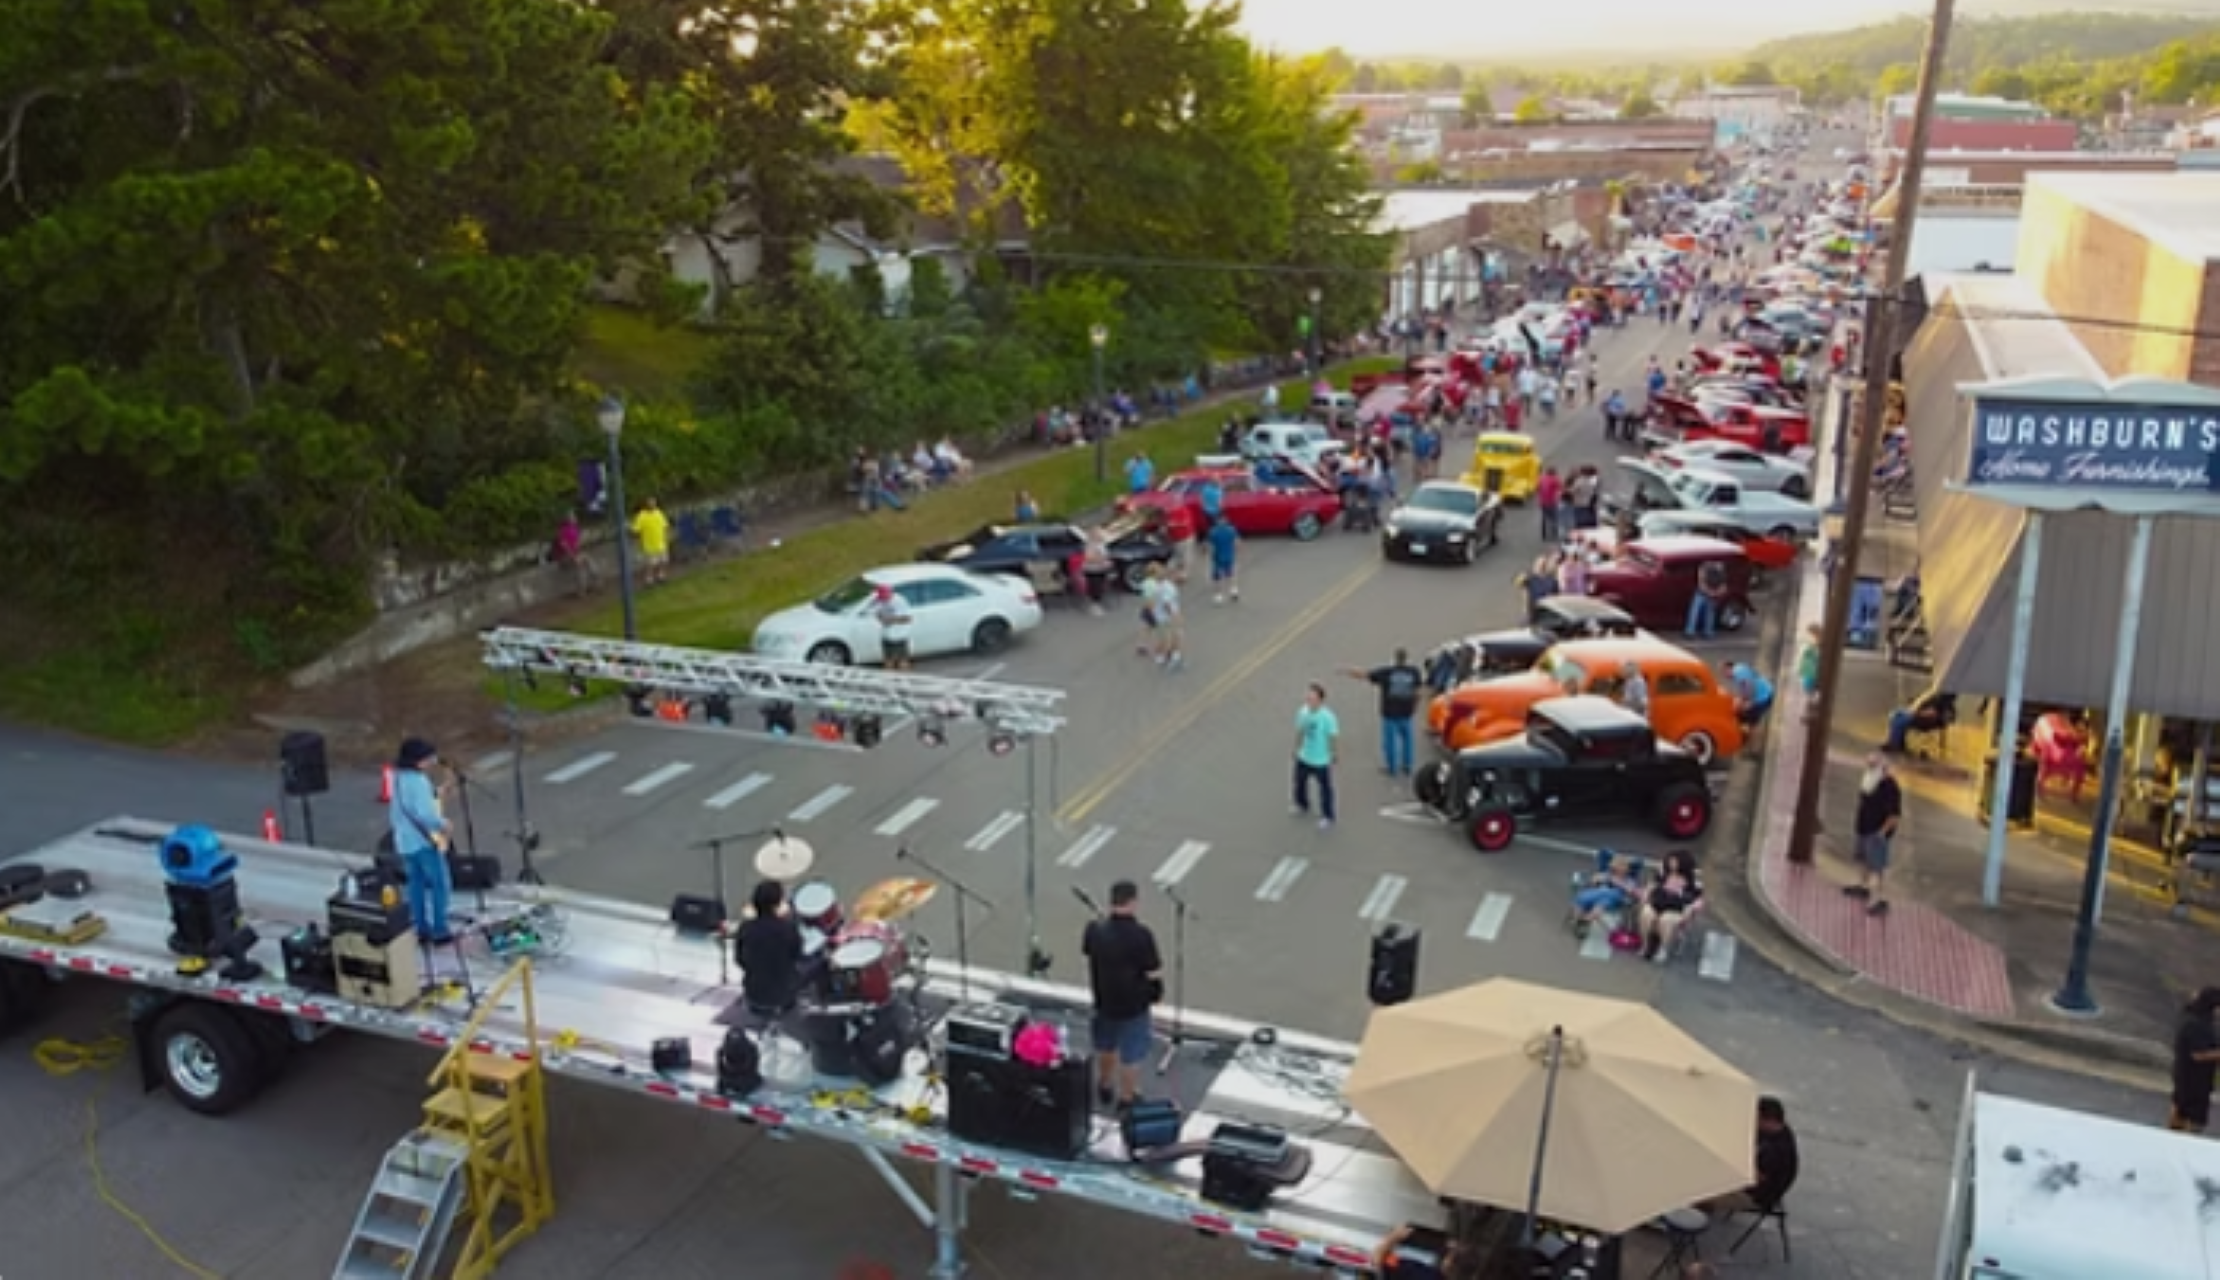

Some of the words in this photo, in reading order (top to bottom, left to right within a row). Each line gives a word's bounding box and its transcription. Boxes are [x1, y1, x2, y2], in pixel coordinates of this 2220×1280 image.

[1985, 413, 2219, 451] WASHBURN'S
[1978, 449, 2051, 478] Home
[2056, 451, 2210, 490] Furnishings
